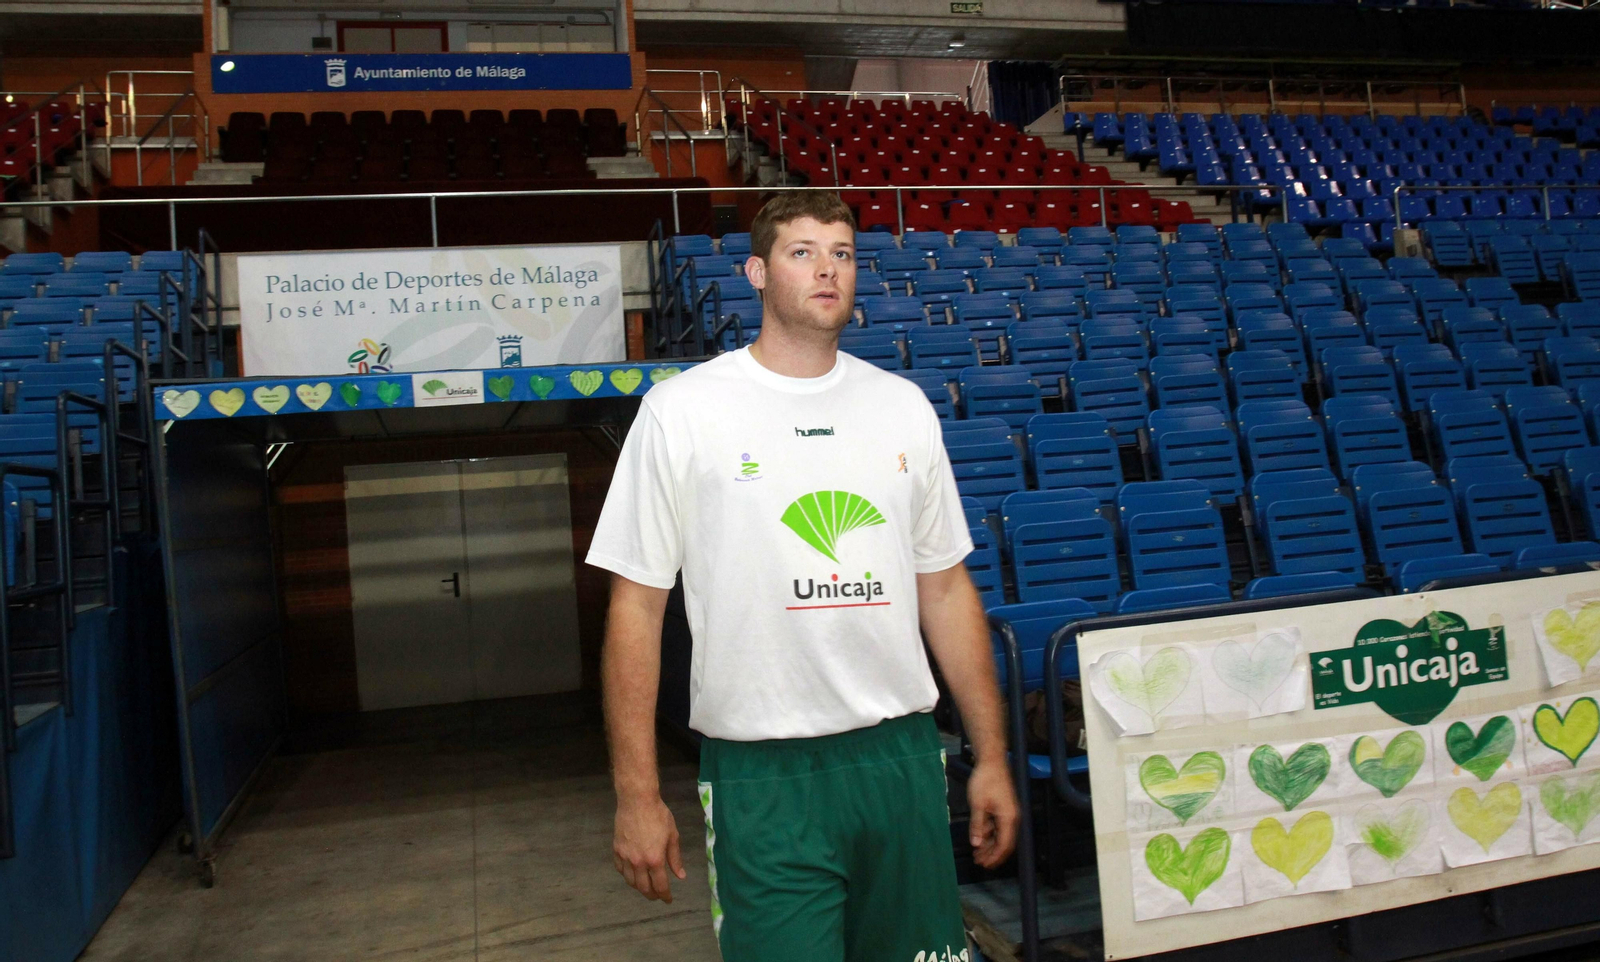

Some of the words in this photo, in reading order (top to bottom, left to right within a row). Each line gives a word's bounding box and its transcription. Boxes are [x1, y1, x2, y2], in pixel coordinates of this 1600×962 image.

[354, 67, 451, 81] Ayuntamiento
[455, 66, 473, 78] de
[476, 66, 526, 80] Málaga
[265, 274, 345, 294] Palacio
[352, 272, 378, 291] de
[384, 271, 483, 295] Deportes
[489, 268, 515, 286] de
[521, 265, 599, 289] Málaga
[266, 300, 323, 323] José
[389, 295, 481, 314] Martín
[491, 294, 601, 313] Carpena
[446, 387, 478, 396] Unicaja
[795, 426, 835, 437] hummel
[793, 571, 884, 602] Unicaja
[1341, 637, 1480, 692] Unicaja
